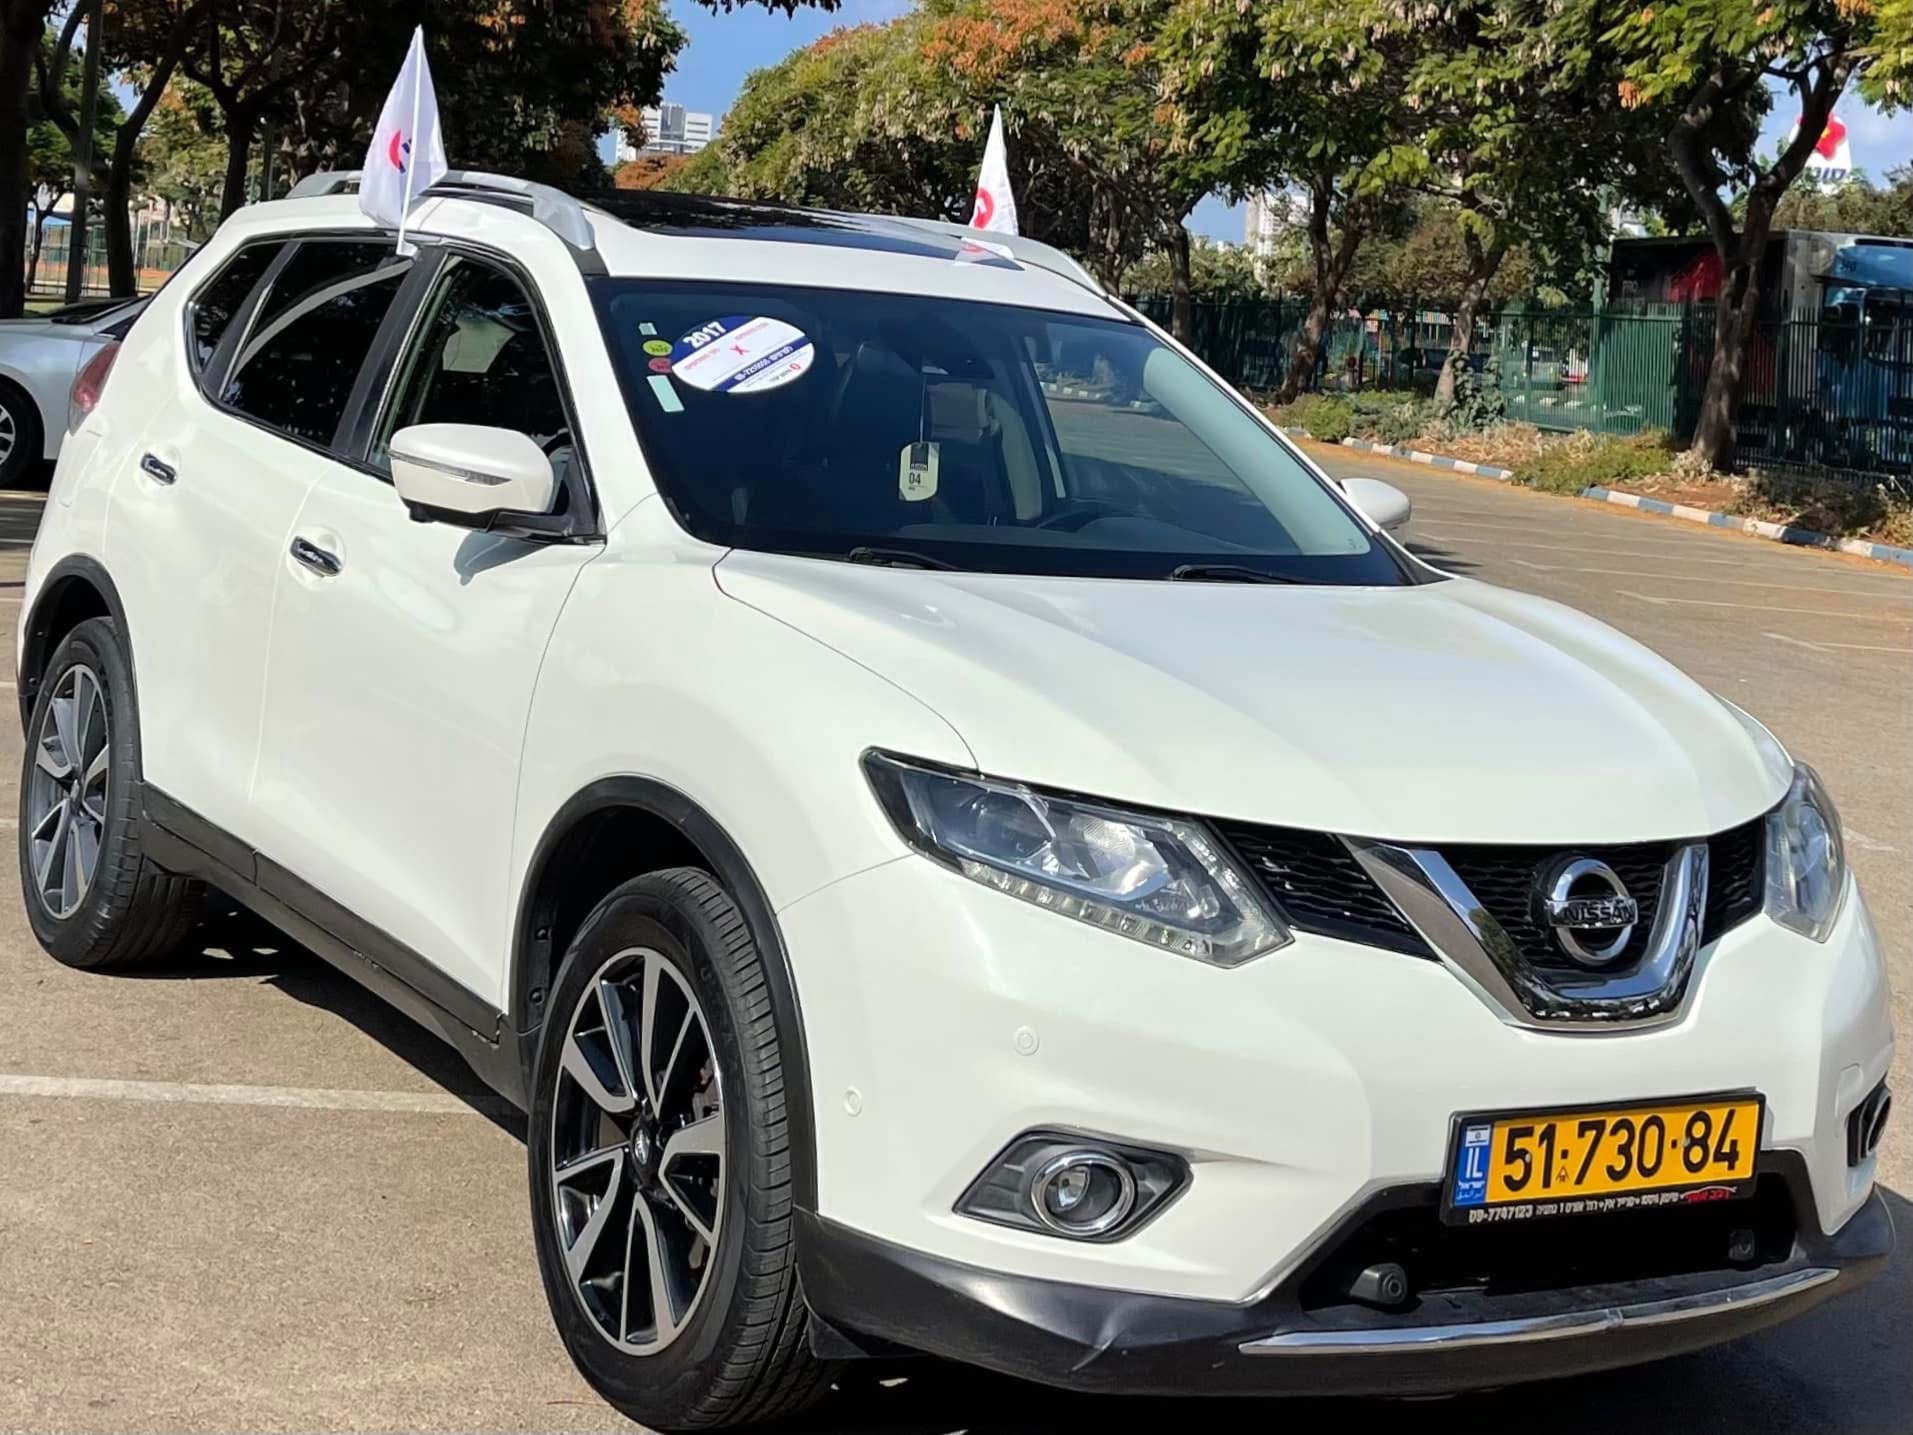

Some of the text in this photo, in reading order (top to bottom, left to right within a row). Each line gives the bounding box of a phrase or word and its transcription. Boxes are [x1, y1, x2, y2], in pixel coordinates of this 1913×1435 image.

[683, 321, 727, 349] 2017
[1562, 901, 1635, 922] NISSAN
[1466, 1147, 1483, 1179] IL
